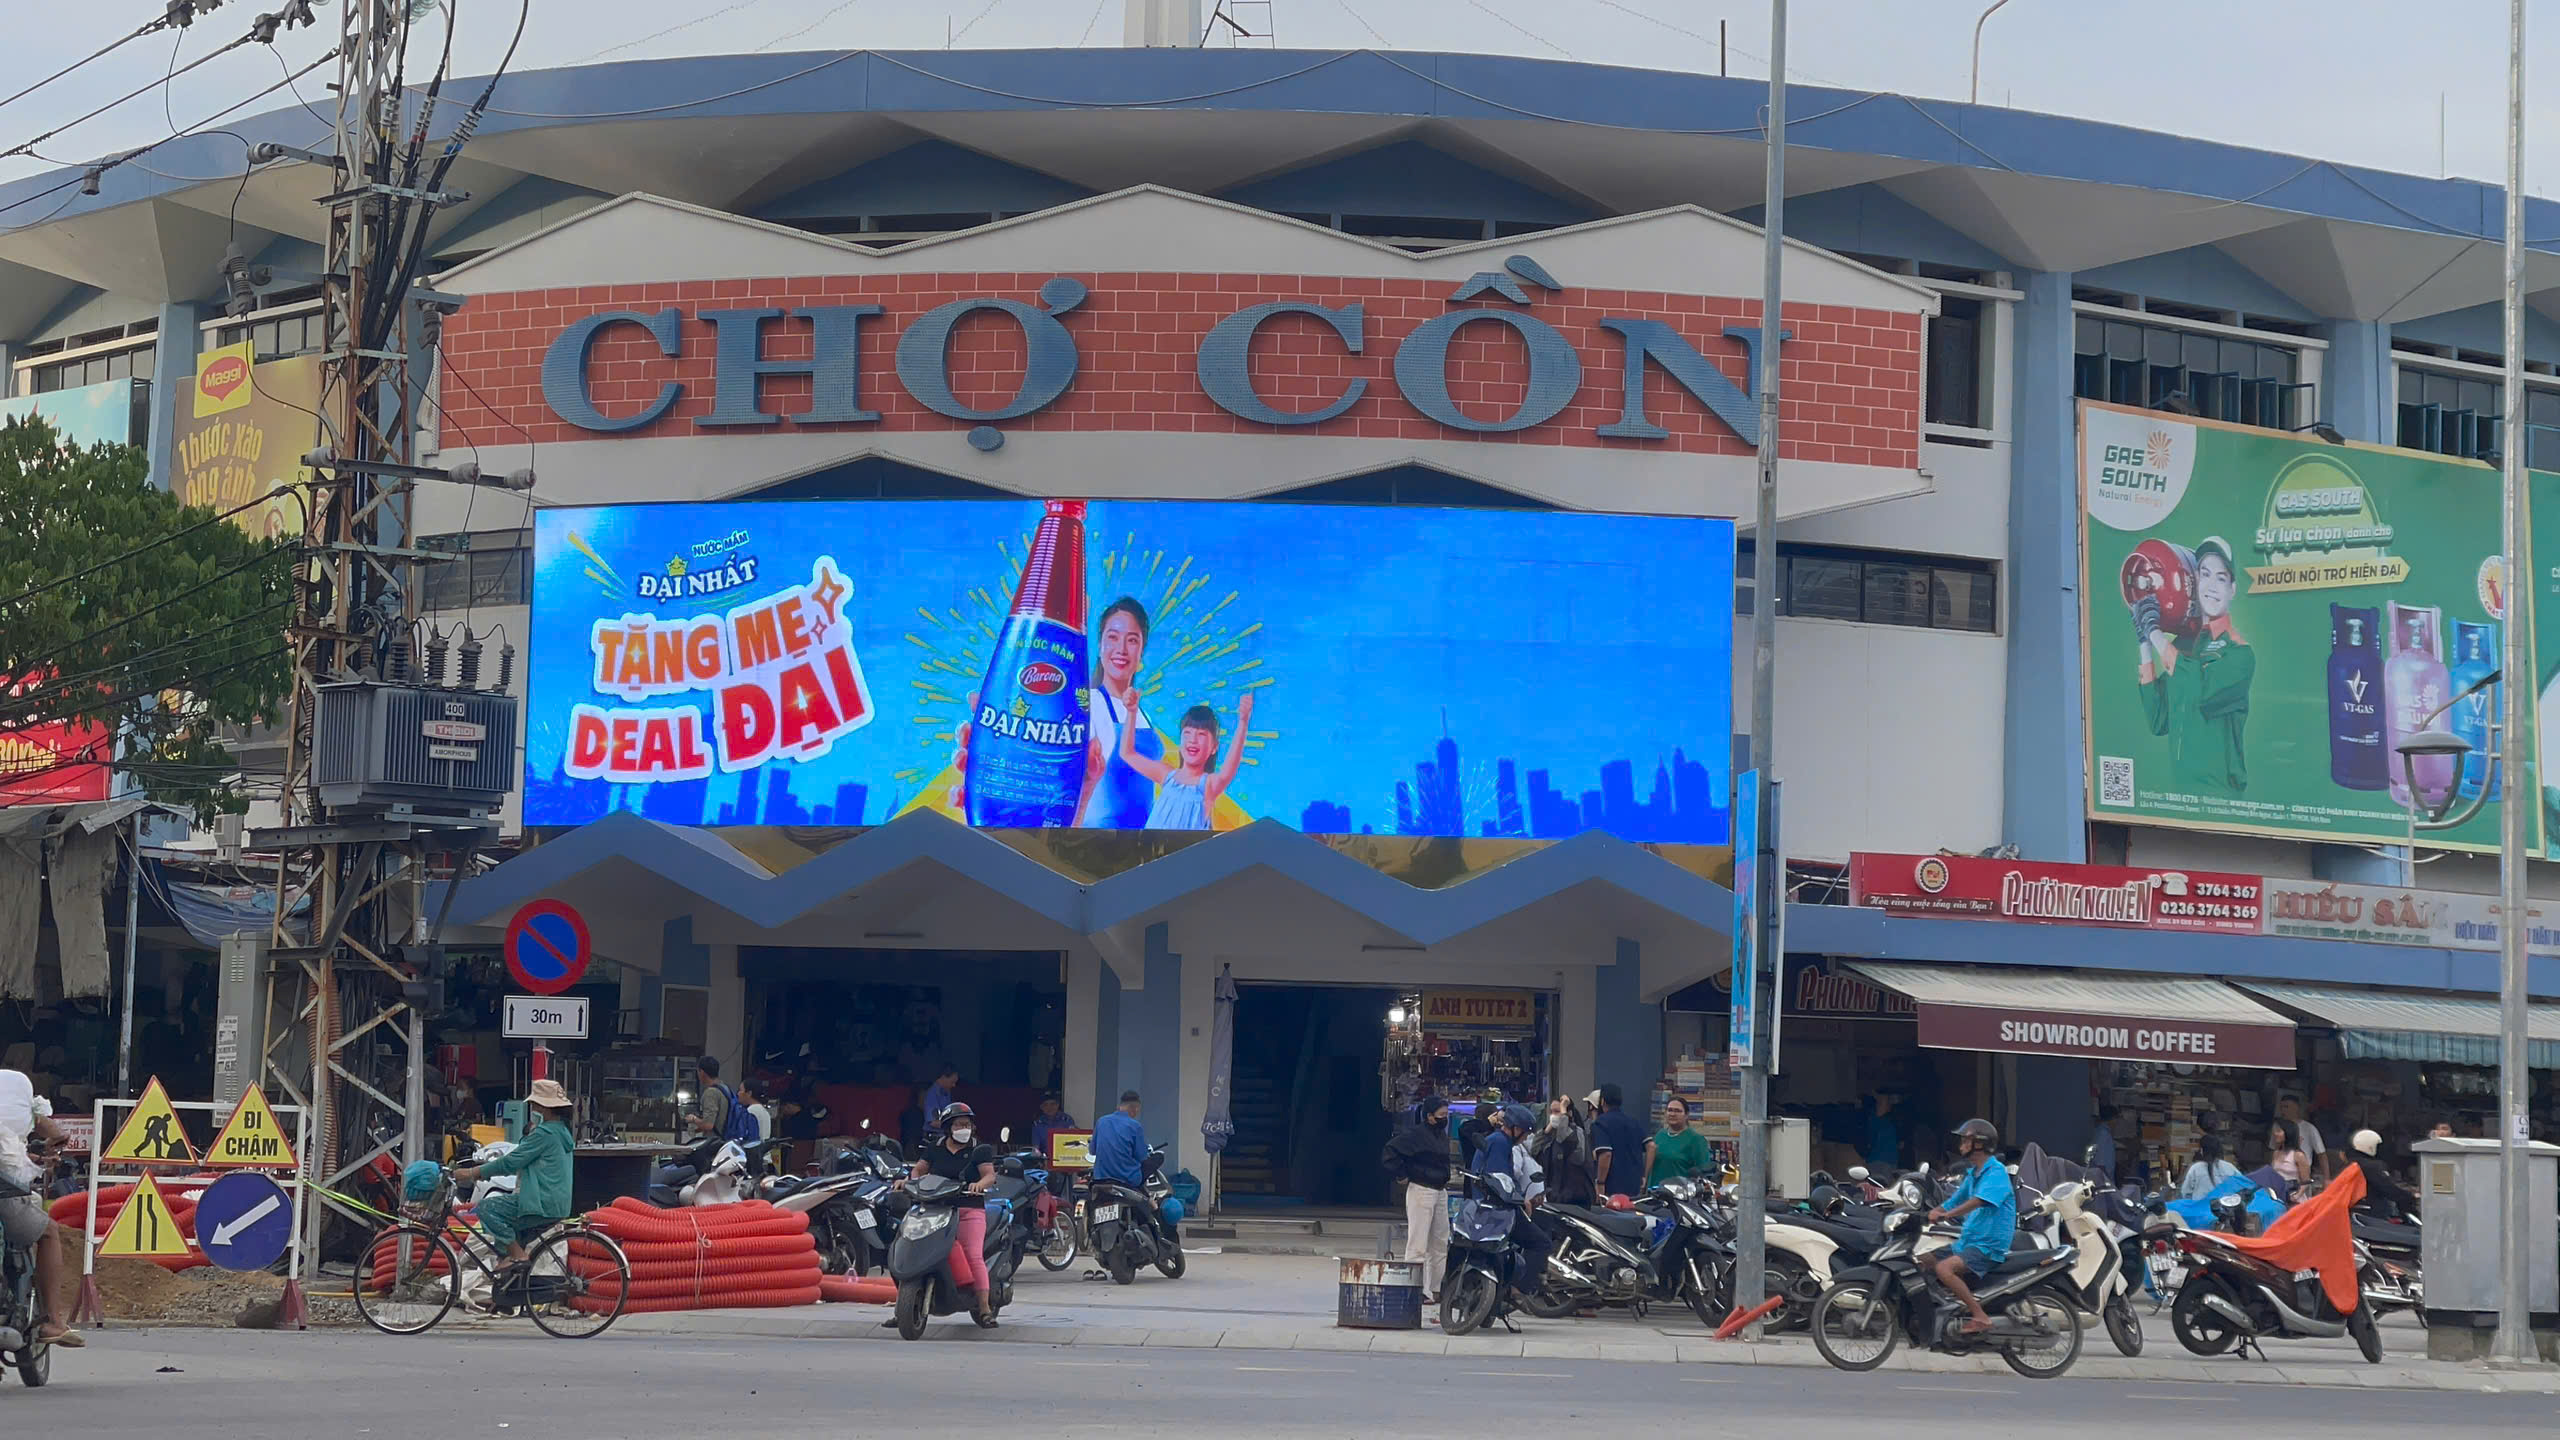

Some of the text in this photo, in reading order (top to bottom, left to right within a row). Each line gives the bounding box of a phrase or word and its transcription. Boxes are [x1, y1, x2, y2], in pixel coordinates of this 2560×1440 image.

[540, 254, 1792, 451] CHỢ CỒN
[205, 365, 241, 388] Maggi
[189, 418, 231, 469] bước
[232, 419, 263, 462] xào
[2104, 444, 2145, 466] GAS
[2101, 467, 2167, 493] SOUTH
[2098, 488, 2132, 502] Natural
[2279, 489, 2361, 508] GAS SOUTH
[693, 541, 721, 556] NƯỚC
[2256, 529, 2276, 551] Sự
[2280, 528, 2302, 549] lựa
[2306, 526, 2342, 546] chọn
[640, 553, 756, 603] ĐẠI NHẤT
[2258, 568, 2296, 585] NGƯỜI
[2300, 566, 2320, 585] NỘI
[2350, 562, 2377, 581] HIỆN
[2381, 564, 2400, 580] ĐẠI
[597, 595, 812, 691] TẶNG MẸ
[1022, 667, 1062, 684] Barona
[447, 704, 464, 715] 400
[571, 645, 866, 772] DEAL ĐẠI
[2343, 702, 2375, 714] VT-GAS
[980, 705, 1085, 745] ĐẠI NHẤT
[2197, 882, 2258, 900] 3764 367
[2160, 903, 2258, 920] 0236 3764 369
[530, 1009, 562, 1024] 30m
[2001, 1020, 2216, 1054] SHOWROOM COFFEE
[244, 1111, 262, 1130] ĐI
[81, 1139, 87, 1149] 3
[225, 1137, 278, 1160] CHẬM
